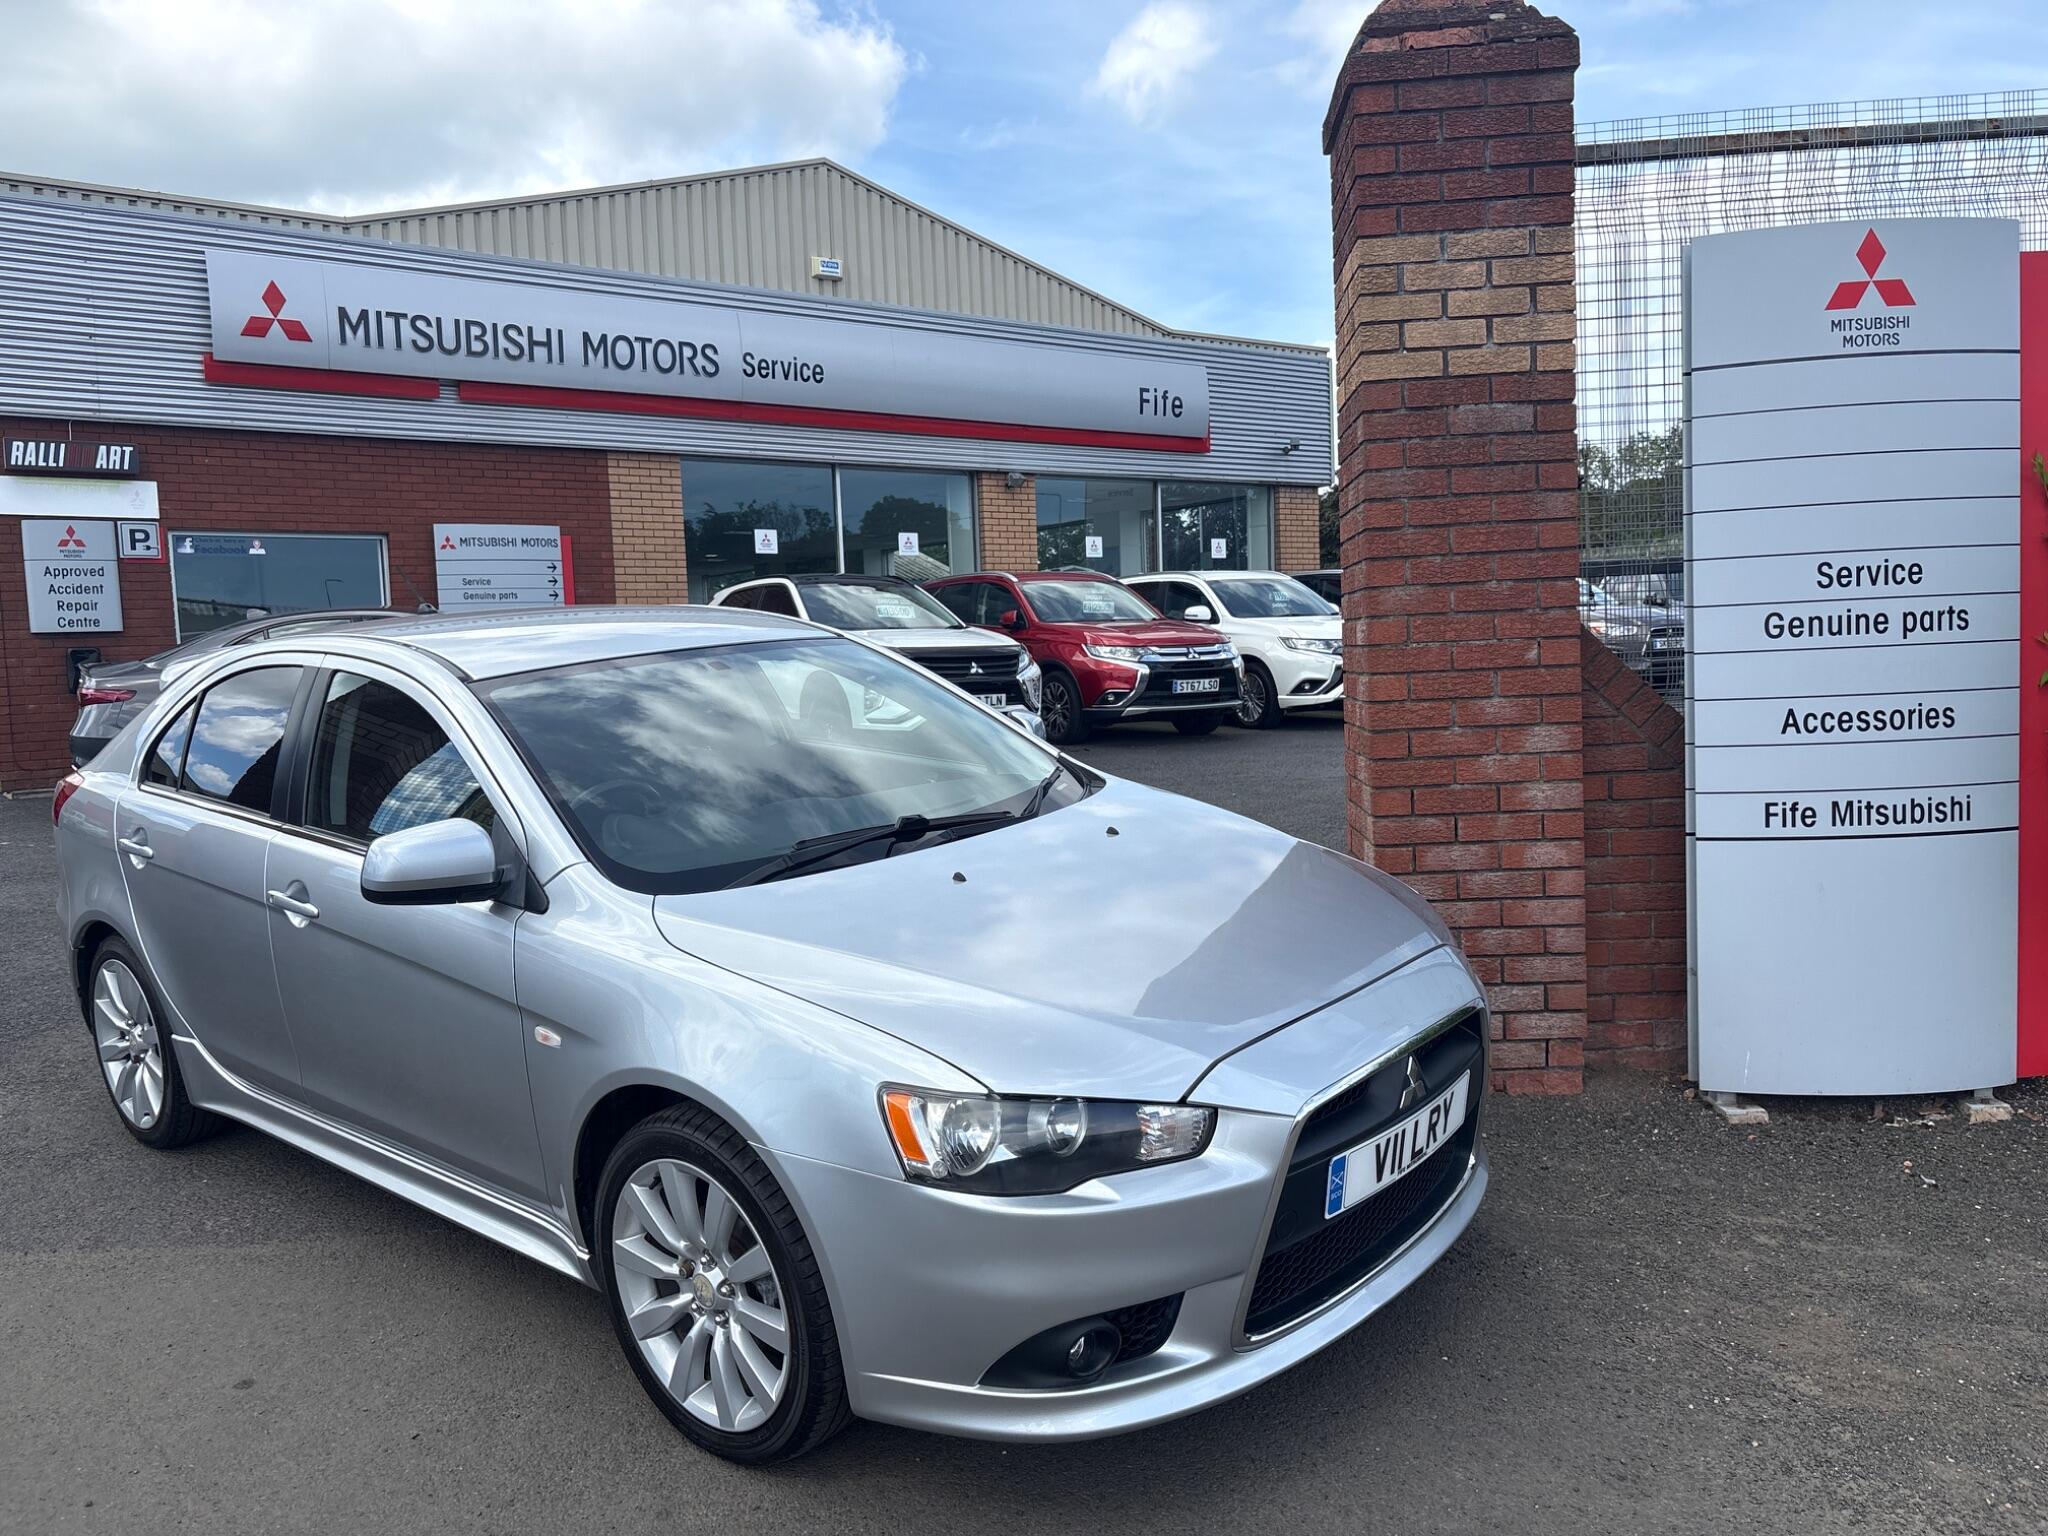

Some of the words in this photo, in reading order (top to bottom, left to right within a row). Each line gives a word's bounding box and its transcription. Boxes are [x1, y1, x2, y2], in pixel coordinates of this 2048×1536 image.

[1831, 315, 1910, 332] MITSUBISHI
[337, 306, 565, 365] MITSUBISHI
[582, 331, 720, 378] MOTORS
[742, 352, 825, 384] Service
[1842, 332, 1900, 348] MOTORS
[1139, 387, 1183, 418] Fife
[10, 441, 66, 467] RALLI
[95, 445, 134, 470] ART
[129, 528, 150, 551] P
[458, 537, 517, 548] MITSUBISHI
[521, 538, 559, 549] MOTORS
[43, 566, 105, 580] Approved
[1816, 558, 1923, 589] Service
[48, 584, 104, 595] Accident
[462, 578, 491, 586] Service
[463, 592, 496, 600] Genuine
[499, 591, 518, 601] parts
[57, 600, 98, 613] Repair
[57, 617, 100, 628] Centre
[1764, 608, 1889, 639] Genuine
[1902, 605, 1969, 639] parts
[1781, 703, 1956, 735] Accessories
[1764, 801, 1817, 828] Fife
[1831, 794, 1971, 827] Mitsubishi
